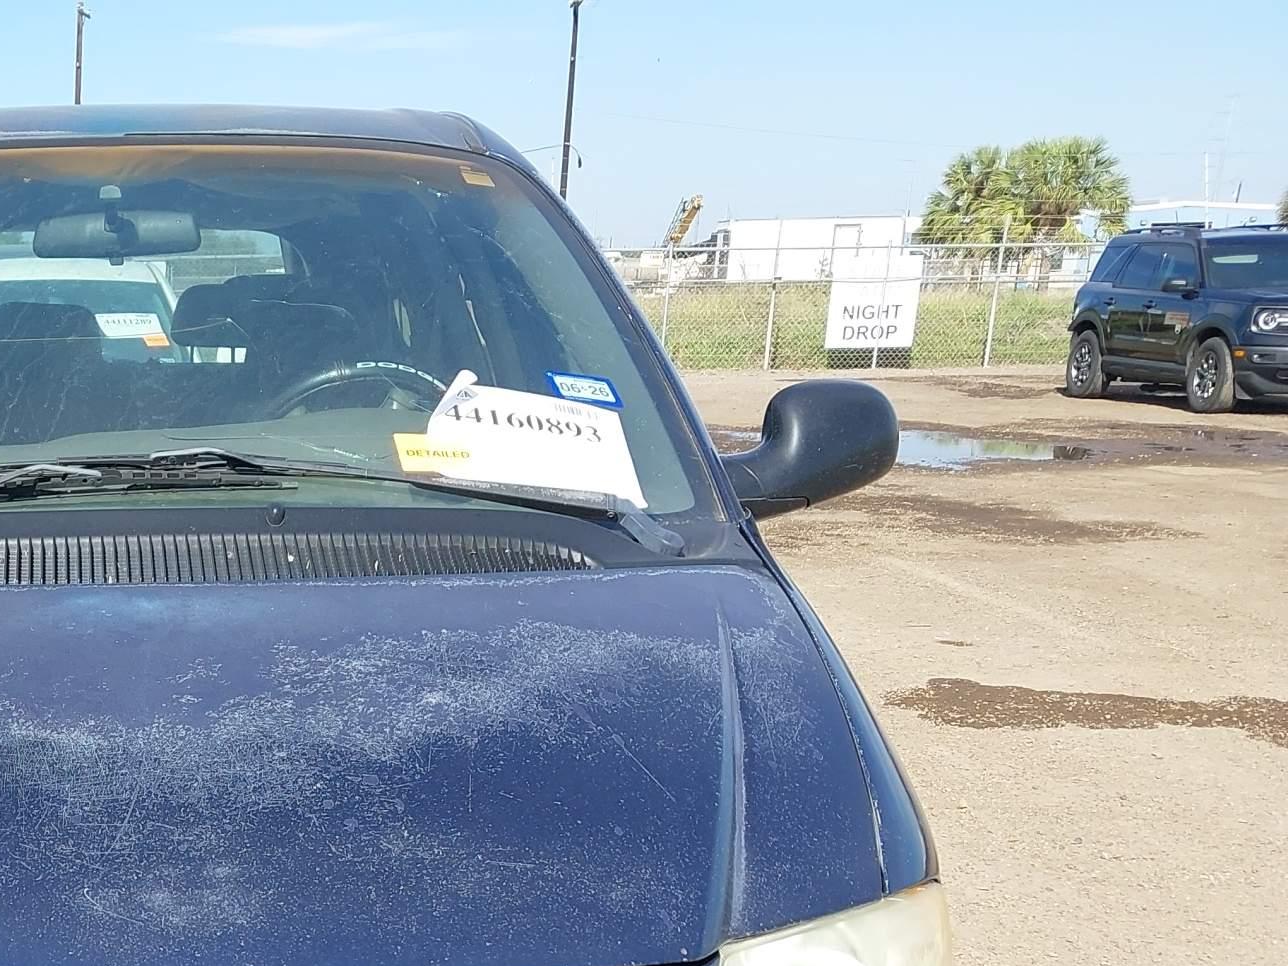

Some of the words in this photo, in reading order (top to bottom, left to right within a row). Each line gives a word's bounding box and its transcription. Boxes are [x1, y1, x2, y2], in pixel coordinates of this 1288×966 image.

[842, 304, 903, 320] NIGHT
[842, 325, 898, 340] DROP
[444, 404, 602, 443] 44160893
[405, 449, 471, 459] DETAILED
